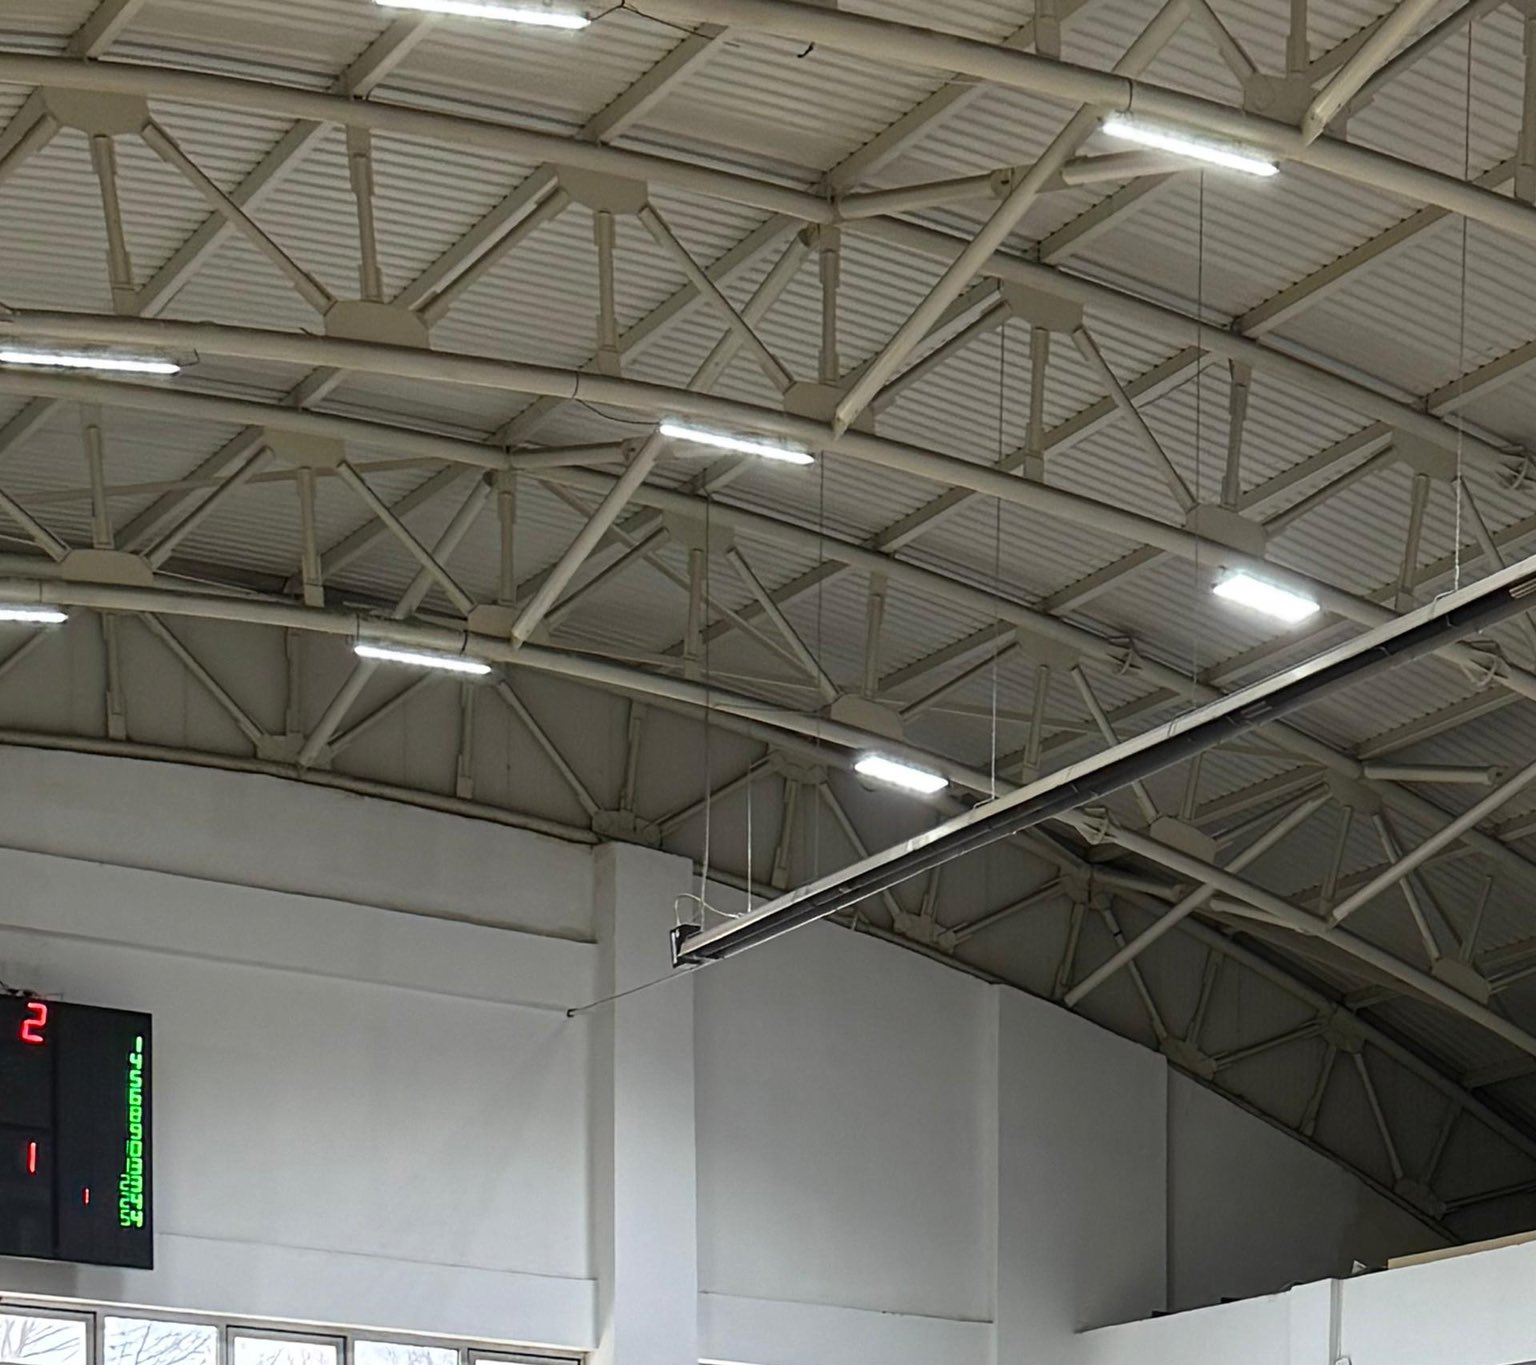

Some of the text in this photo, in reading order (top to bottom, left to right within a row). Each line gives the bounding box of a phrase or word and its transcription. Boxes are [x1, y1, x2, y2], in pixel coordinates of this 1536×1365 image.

[20, 1002, 48, 1043] 2
[129, 1069, 143, 1087] 5
[129, 1087, 143, 1105] 6
[128, 1105, 143, 1123] 8
[129, 1123, 143, 1140] 9
